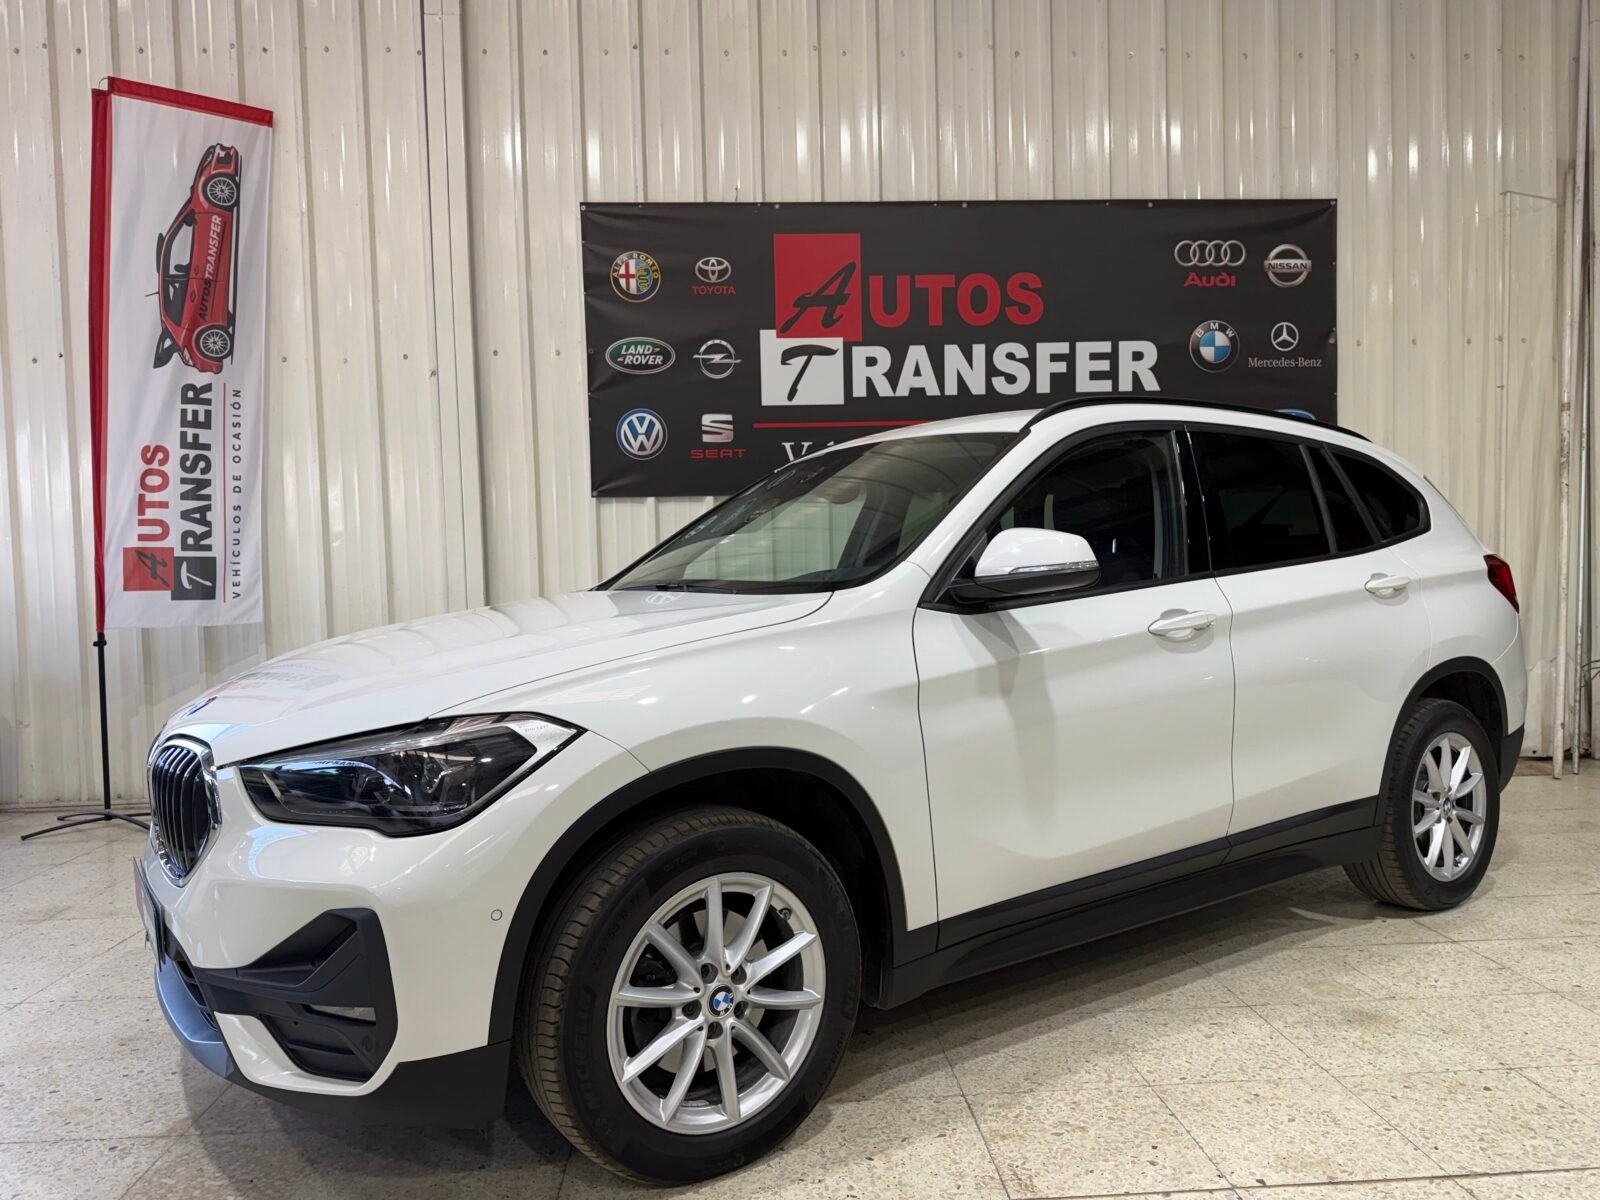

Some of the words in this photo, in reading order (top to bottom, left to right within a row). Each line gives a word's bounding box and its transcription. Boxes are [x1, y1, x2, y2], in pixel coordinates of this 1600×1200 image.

[1184, 271, 1236, 287] Audi
[1267, 262, 1308, 270] NISSAN
[691, 285, 736, 296] TOYOTA
[779, 261, 1044, 334] AUTOS
[780, 339, 1161, 402] TRANSFER
[1247, 357, 1322, 368] Mercedes-Benz
[229, 389, 242, 464] OCASIÓN
[690, 448, 747, 459] SEAT
[179, 382, 213, 590] TRANSFER
[232, 474, 242, 494] DE
[134, 444, 171, 587] AUTOS
[229, 504, 242, 599] VEHÍCULOS
